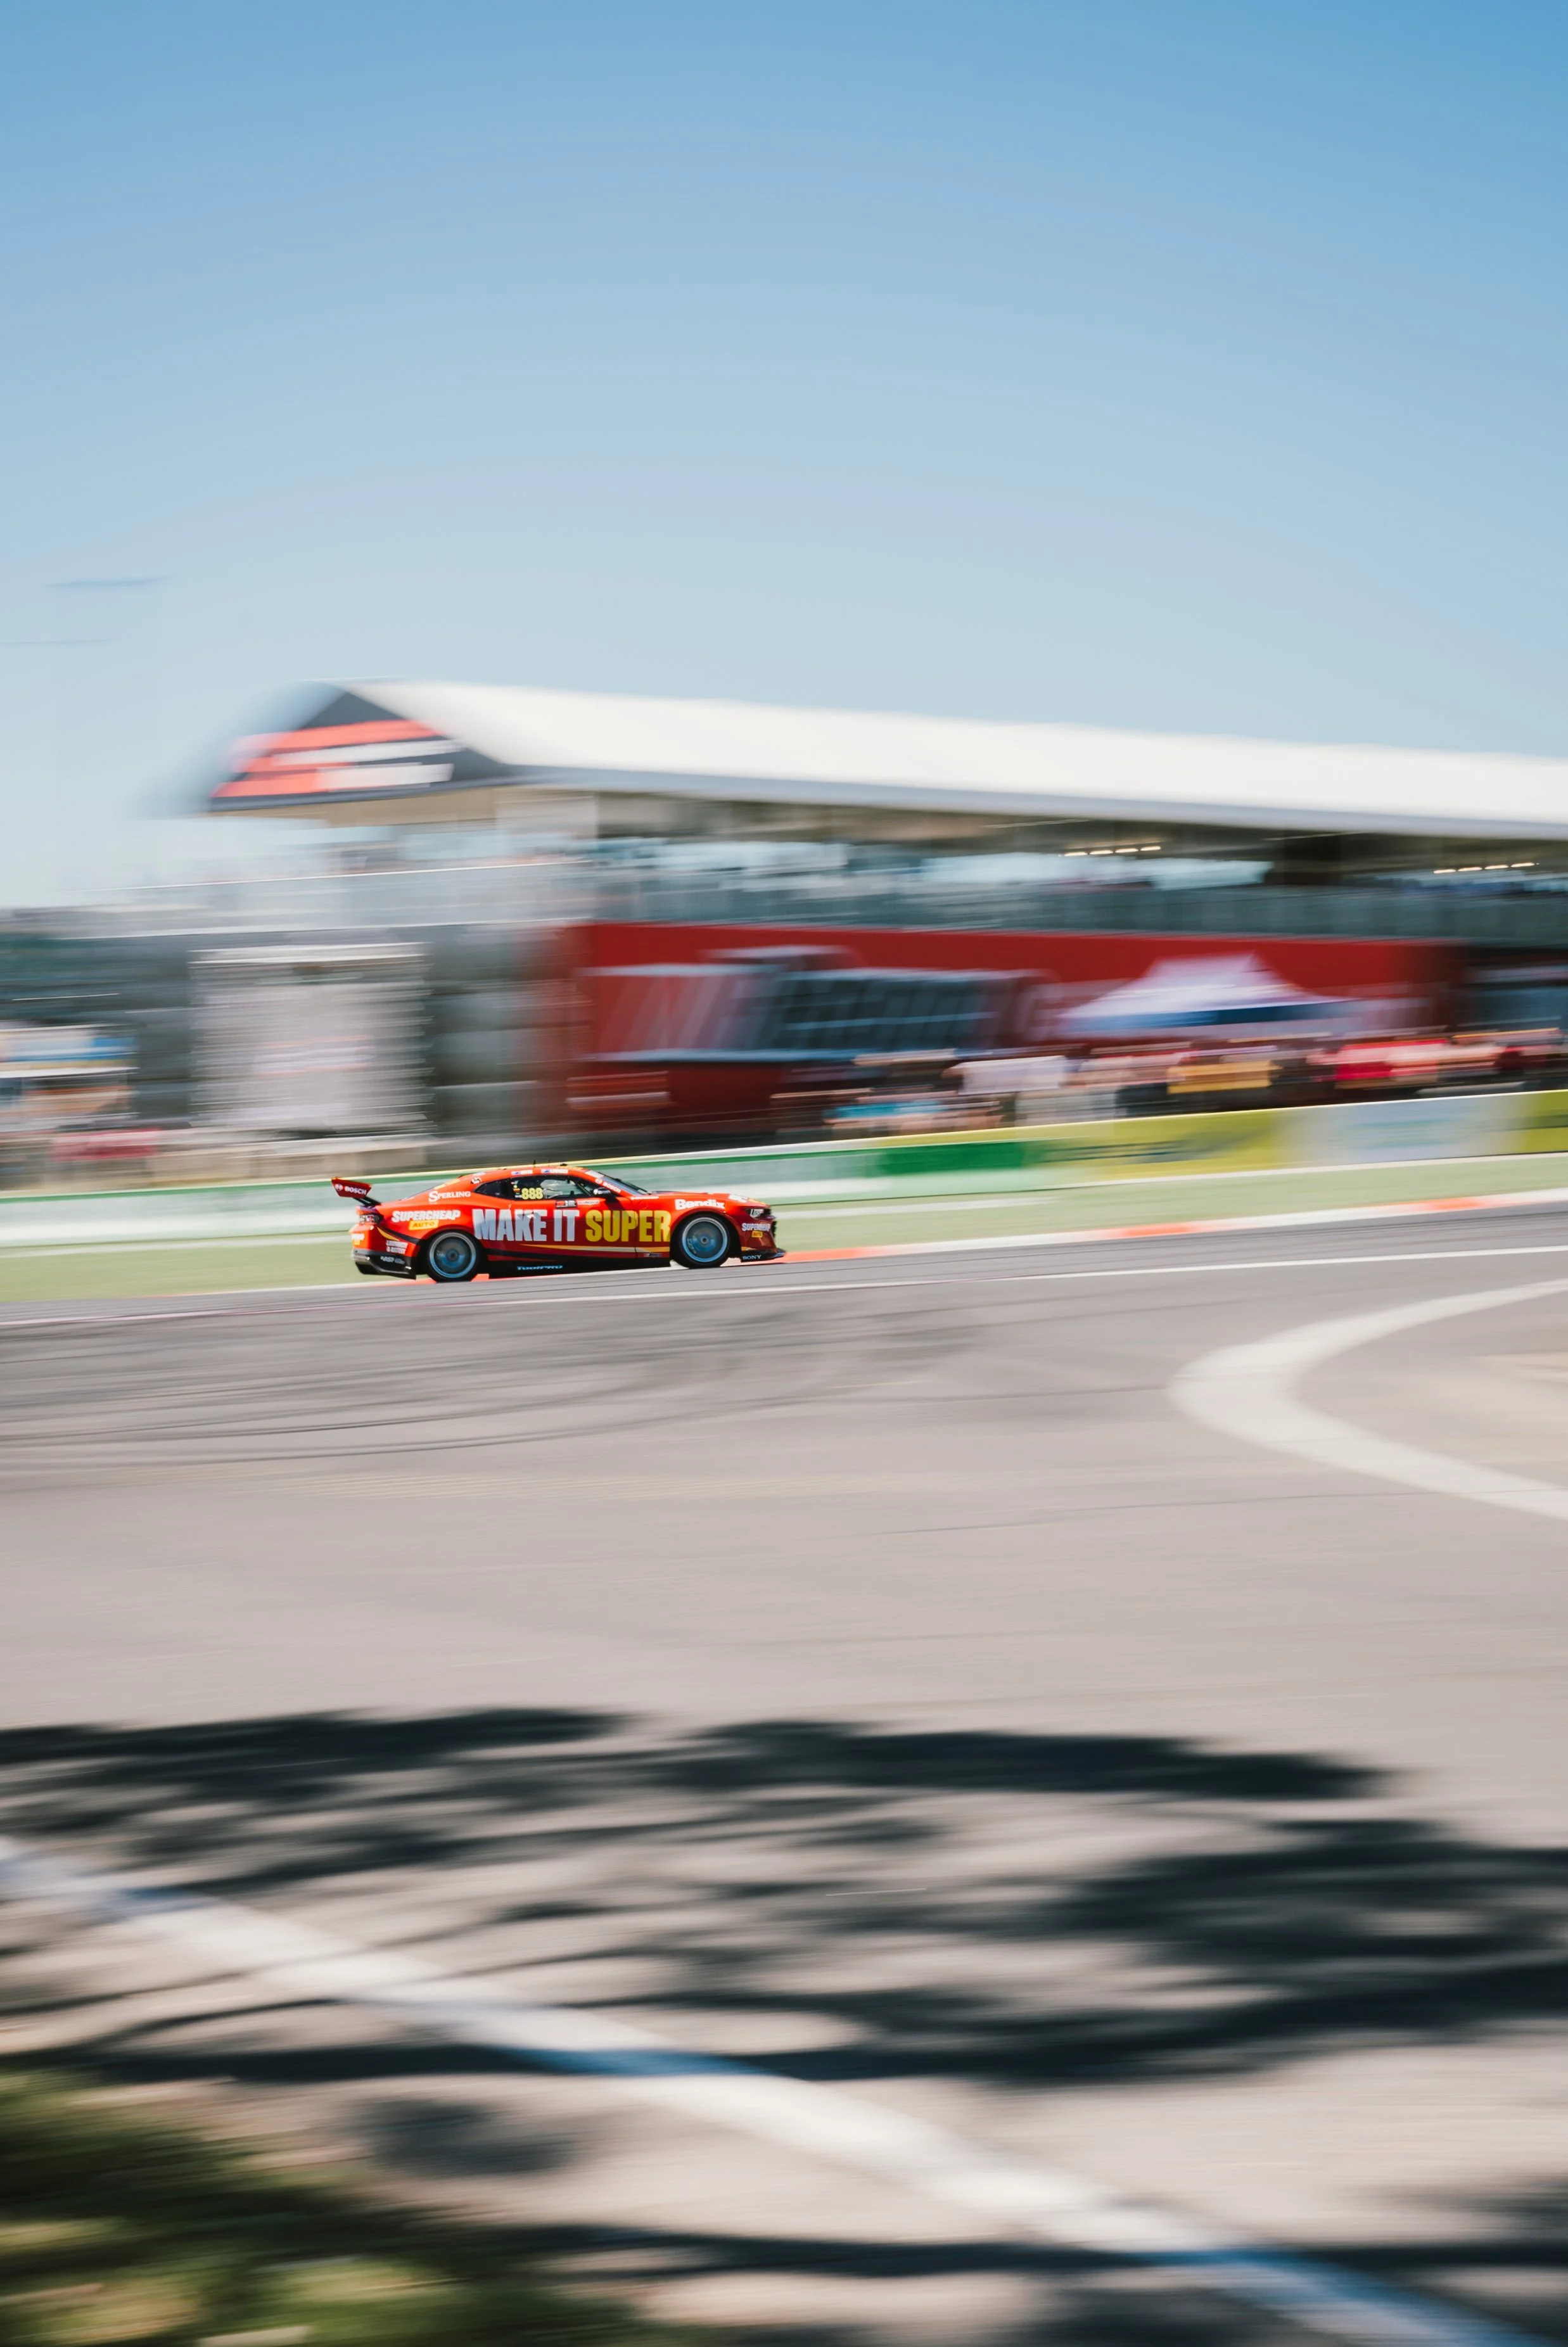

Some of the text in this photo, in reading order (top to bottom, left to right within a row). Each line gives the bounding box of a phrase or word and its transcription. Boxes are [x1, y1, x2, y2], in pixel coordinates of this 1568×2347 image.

[344, 1186, 367, 1195] BOSCH
[521, 1188, 543, 1199] 888
[428, 1191, 471, 1202] SPERLING
[675, 1199, 725, 1210] Bendix
[391, 1210, 461, 1223] SUPERCHEAP
[472, 1209, 672, 1242] MAKE IT SUPER
